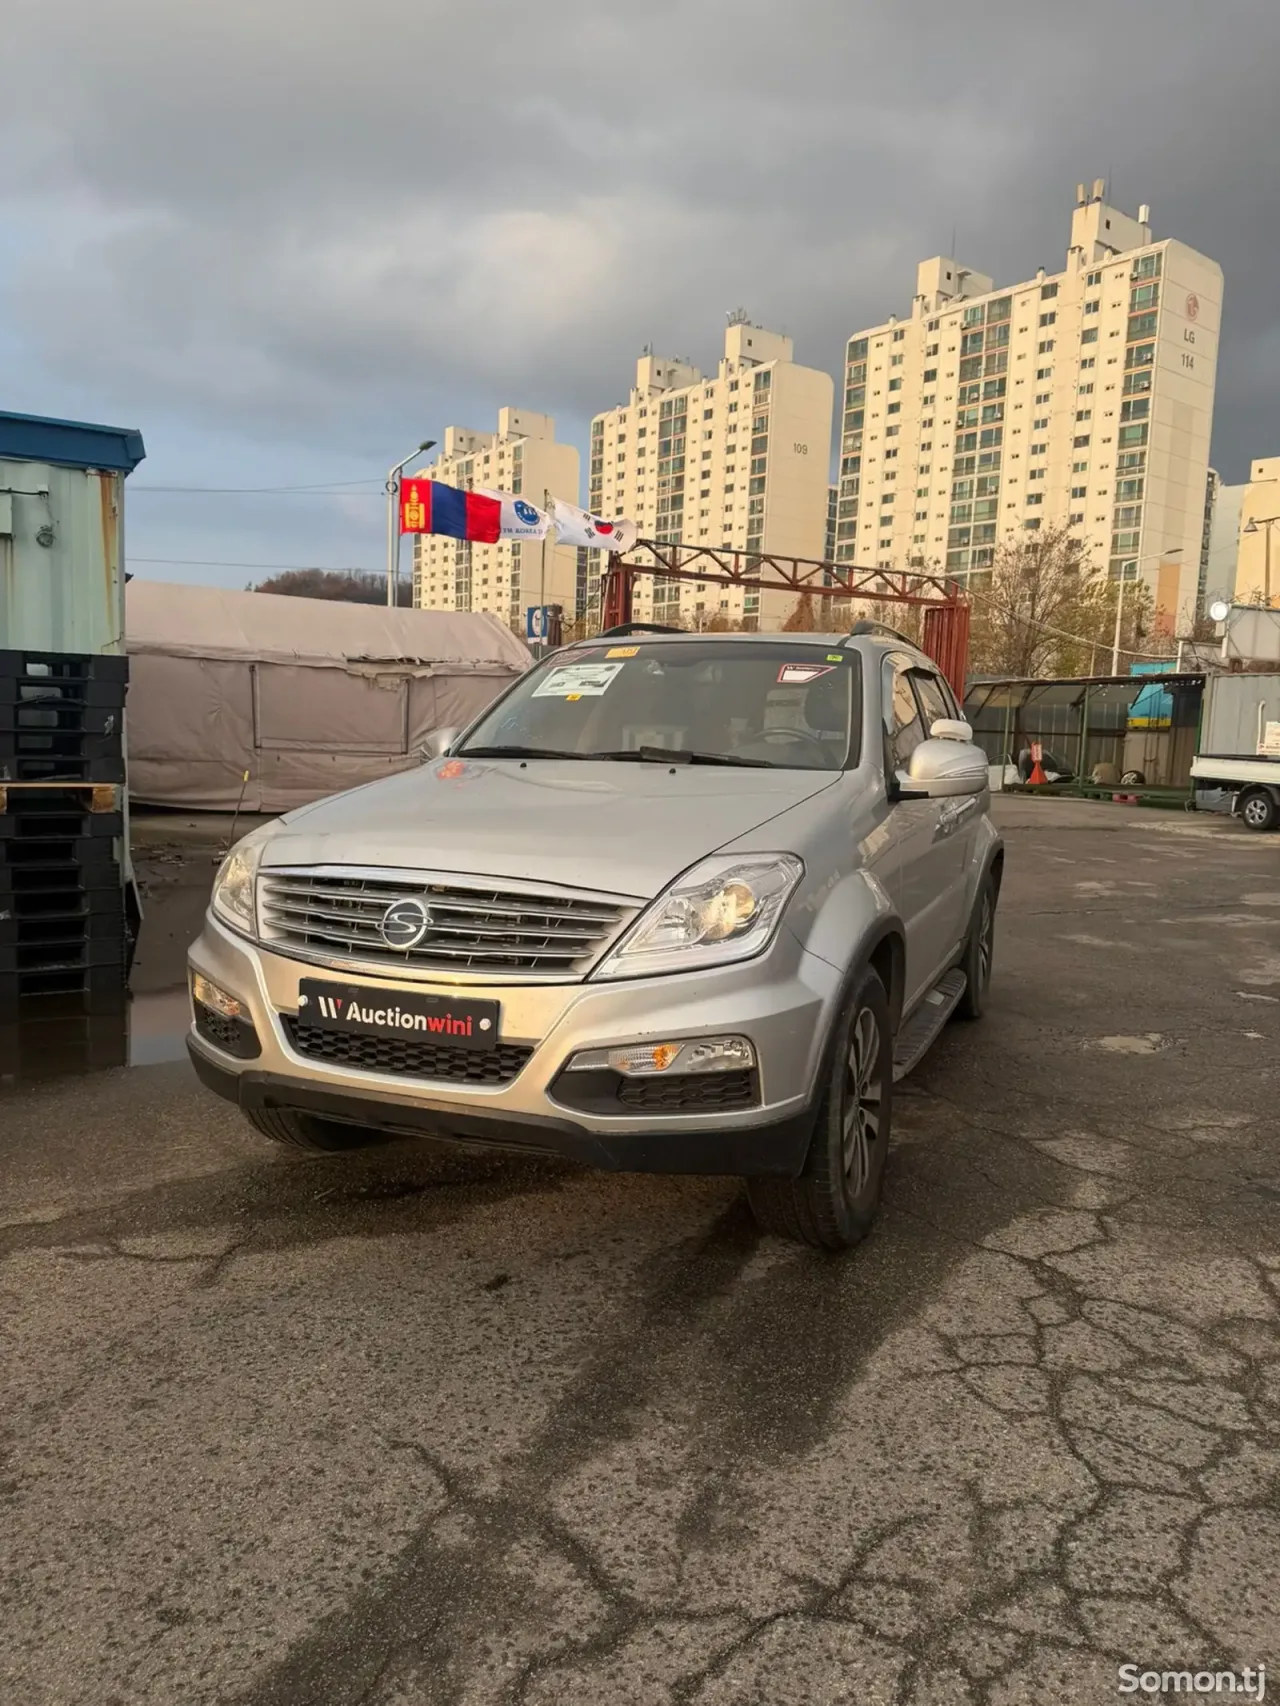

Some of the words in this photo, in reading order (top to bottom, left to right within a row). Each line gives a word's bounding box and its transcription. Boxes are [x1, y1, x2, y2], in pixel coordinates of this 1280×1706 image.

[1184, 328, 1195, 344] LG
[1181, 353, 1194, 369] 114
[793, 442, 808, 455] 109
[346, 1001, 473, 1036] Auctionwini
